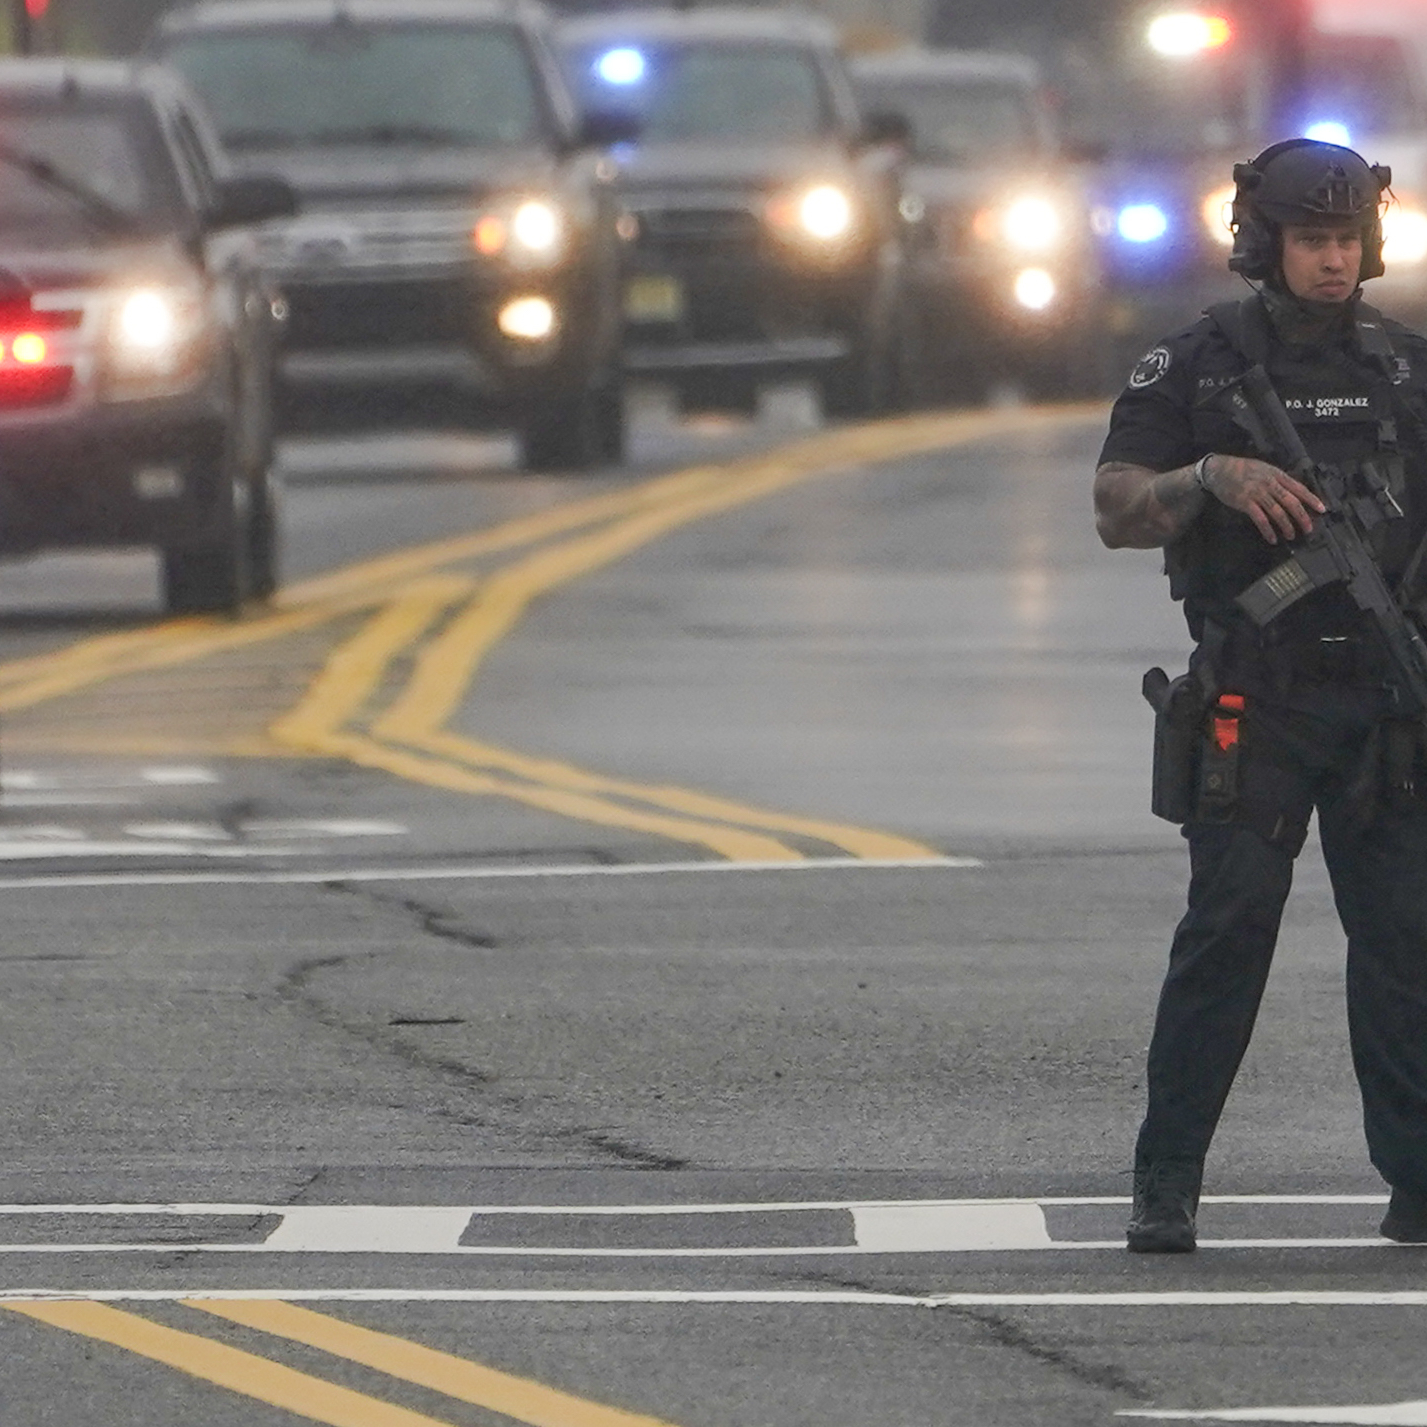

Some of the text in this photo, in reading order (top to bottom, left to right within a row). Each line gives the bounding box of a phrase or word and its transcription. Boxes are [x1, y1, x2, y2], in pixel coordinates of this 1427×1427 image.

[1285, 397, 1369, 409] P.O. J. GONZALEZ
[1314, 407, 1340, 418] 3472
